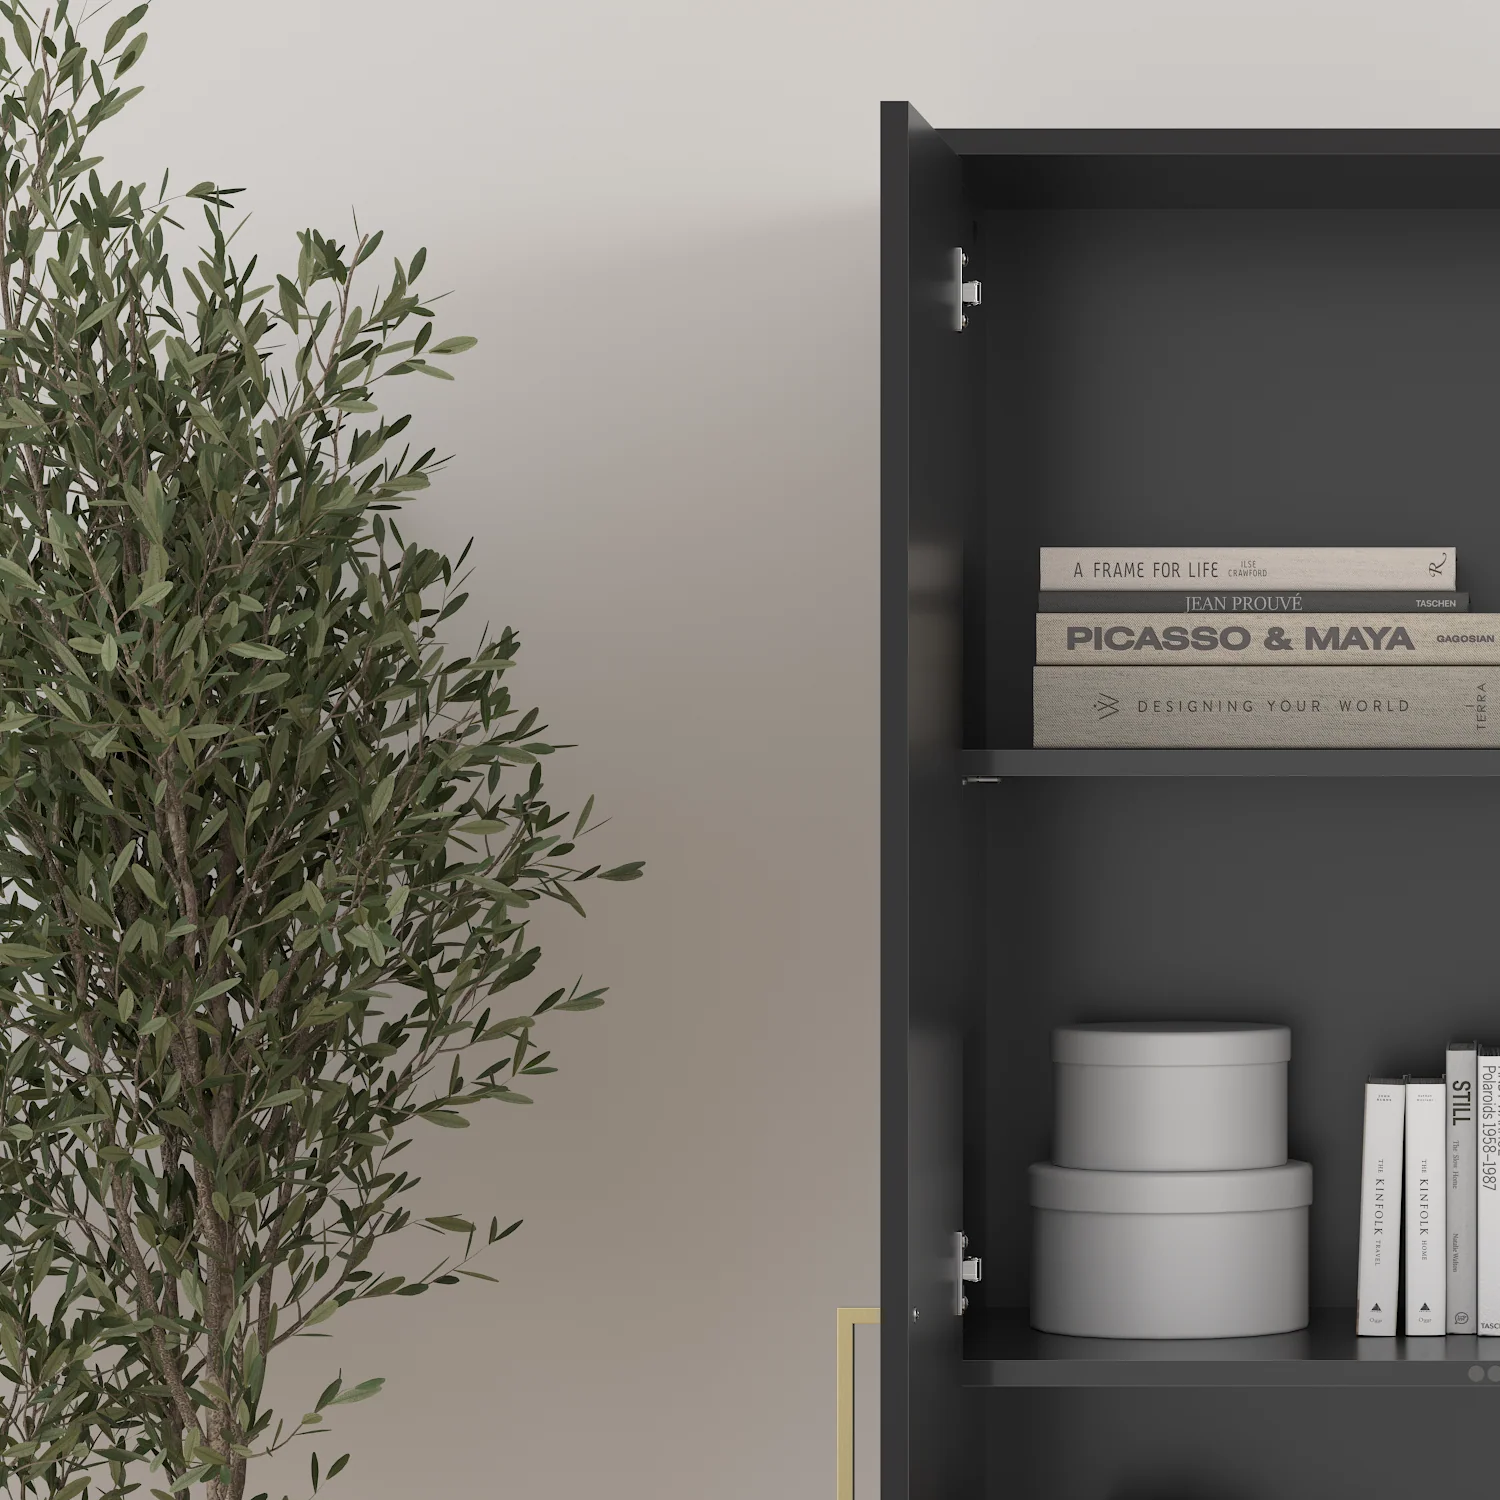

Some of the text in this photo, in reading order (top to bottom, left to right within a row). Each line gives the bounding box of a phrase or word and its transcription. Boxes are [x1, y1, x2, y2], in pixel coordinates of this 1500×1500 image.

[1073, 561, 1219, 578] A FRAME FOR LIFE
[1228, 569, 1268, 577] CRAWFORD
[1184, 593, 1303, 613] JEAN PROUVÉ
[1415, 600, 1456, 608] TASCHEN
[1066, 626, 1416, 651] PICASSO & MAYA
[1436, 634, 1495, 643] GAGOSIAN
[1137, 700, 1410, 713] DESIGNING YOUR WORLD
[1476, 682, 1487, 731] TERRA
[1482, 1066, 1497, 1120] Polaroids
[1452, 1080, 1471, 1126] STILL
[1452, 1140, 1460, 1153] The
[1452, 1173, 1460, 1190] Home
[1374, 1178, 1385, 1236] KINFOLK
[1419, 1178, 1429, 1236] KINFOLK
